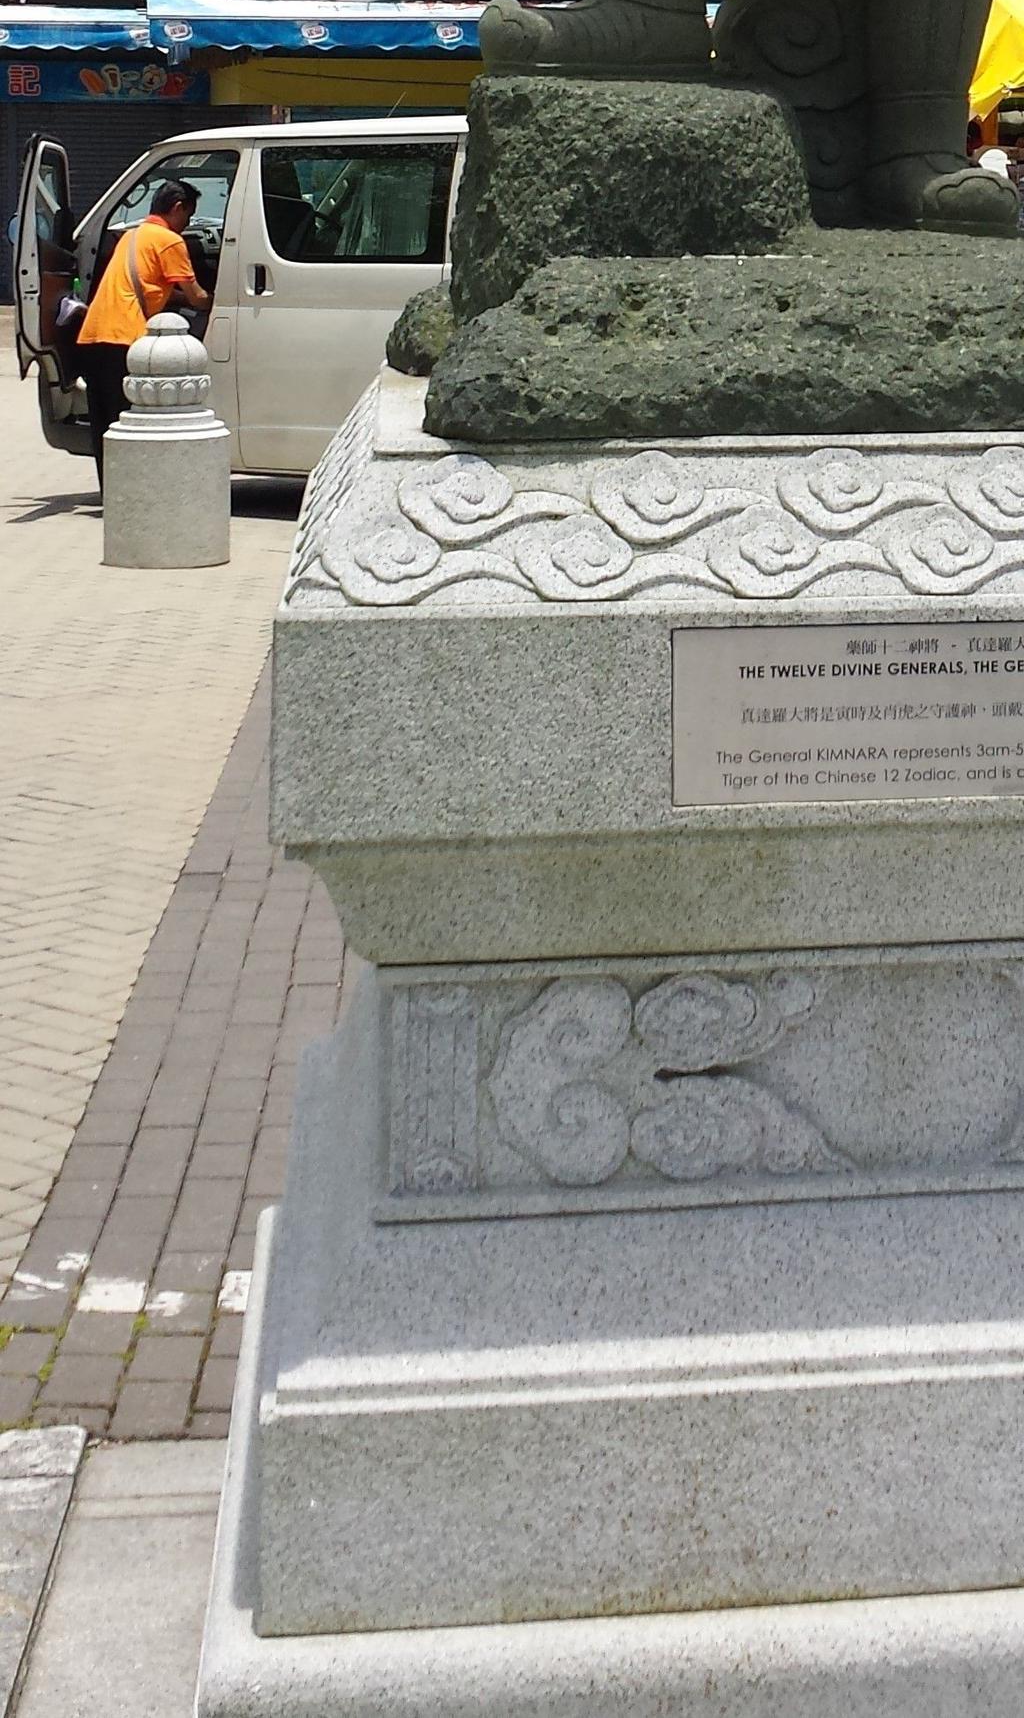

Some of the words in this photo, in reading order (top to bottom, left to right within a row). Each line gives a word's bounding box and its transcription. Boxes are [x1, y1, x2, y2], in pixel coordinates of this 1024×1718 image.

[9, 65, 41, 97] 記
[739, 665, 765, 679] THE
[770, 664, 826, 678] TWELVE
[831, 663, 882, 676] DIVINE
[887, 660, 968, 676] GENERALS,
[973, 660, 998, 673] THE
[716, 751, 742, 764] The
[749, 749, 811, 763] General
[816, 747, 889, 762] KIMNARA
[892, 744, 971, 761] represents
[722, 772, 758, 790] Tiger
[763, 771, 779, 786] of
[784, 771, 810, 785] the
[814, 769, 876, 784] Chinese
[882, 768, 899, 782] 12
[966, 766, 997, 780] and
[1001, 764, 1012, 779] is
